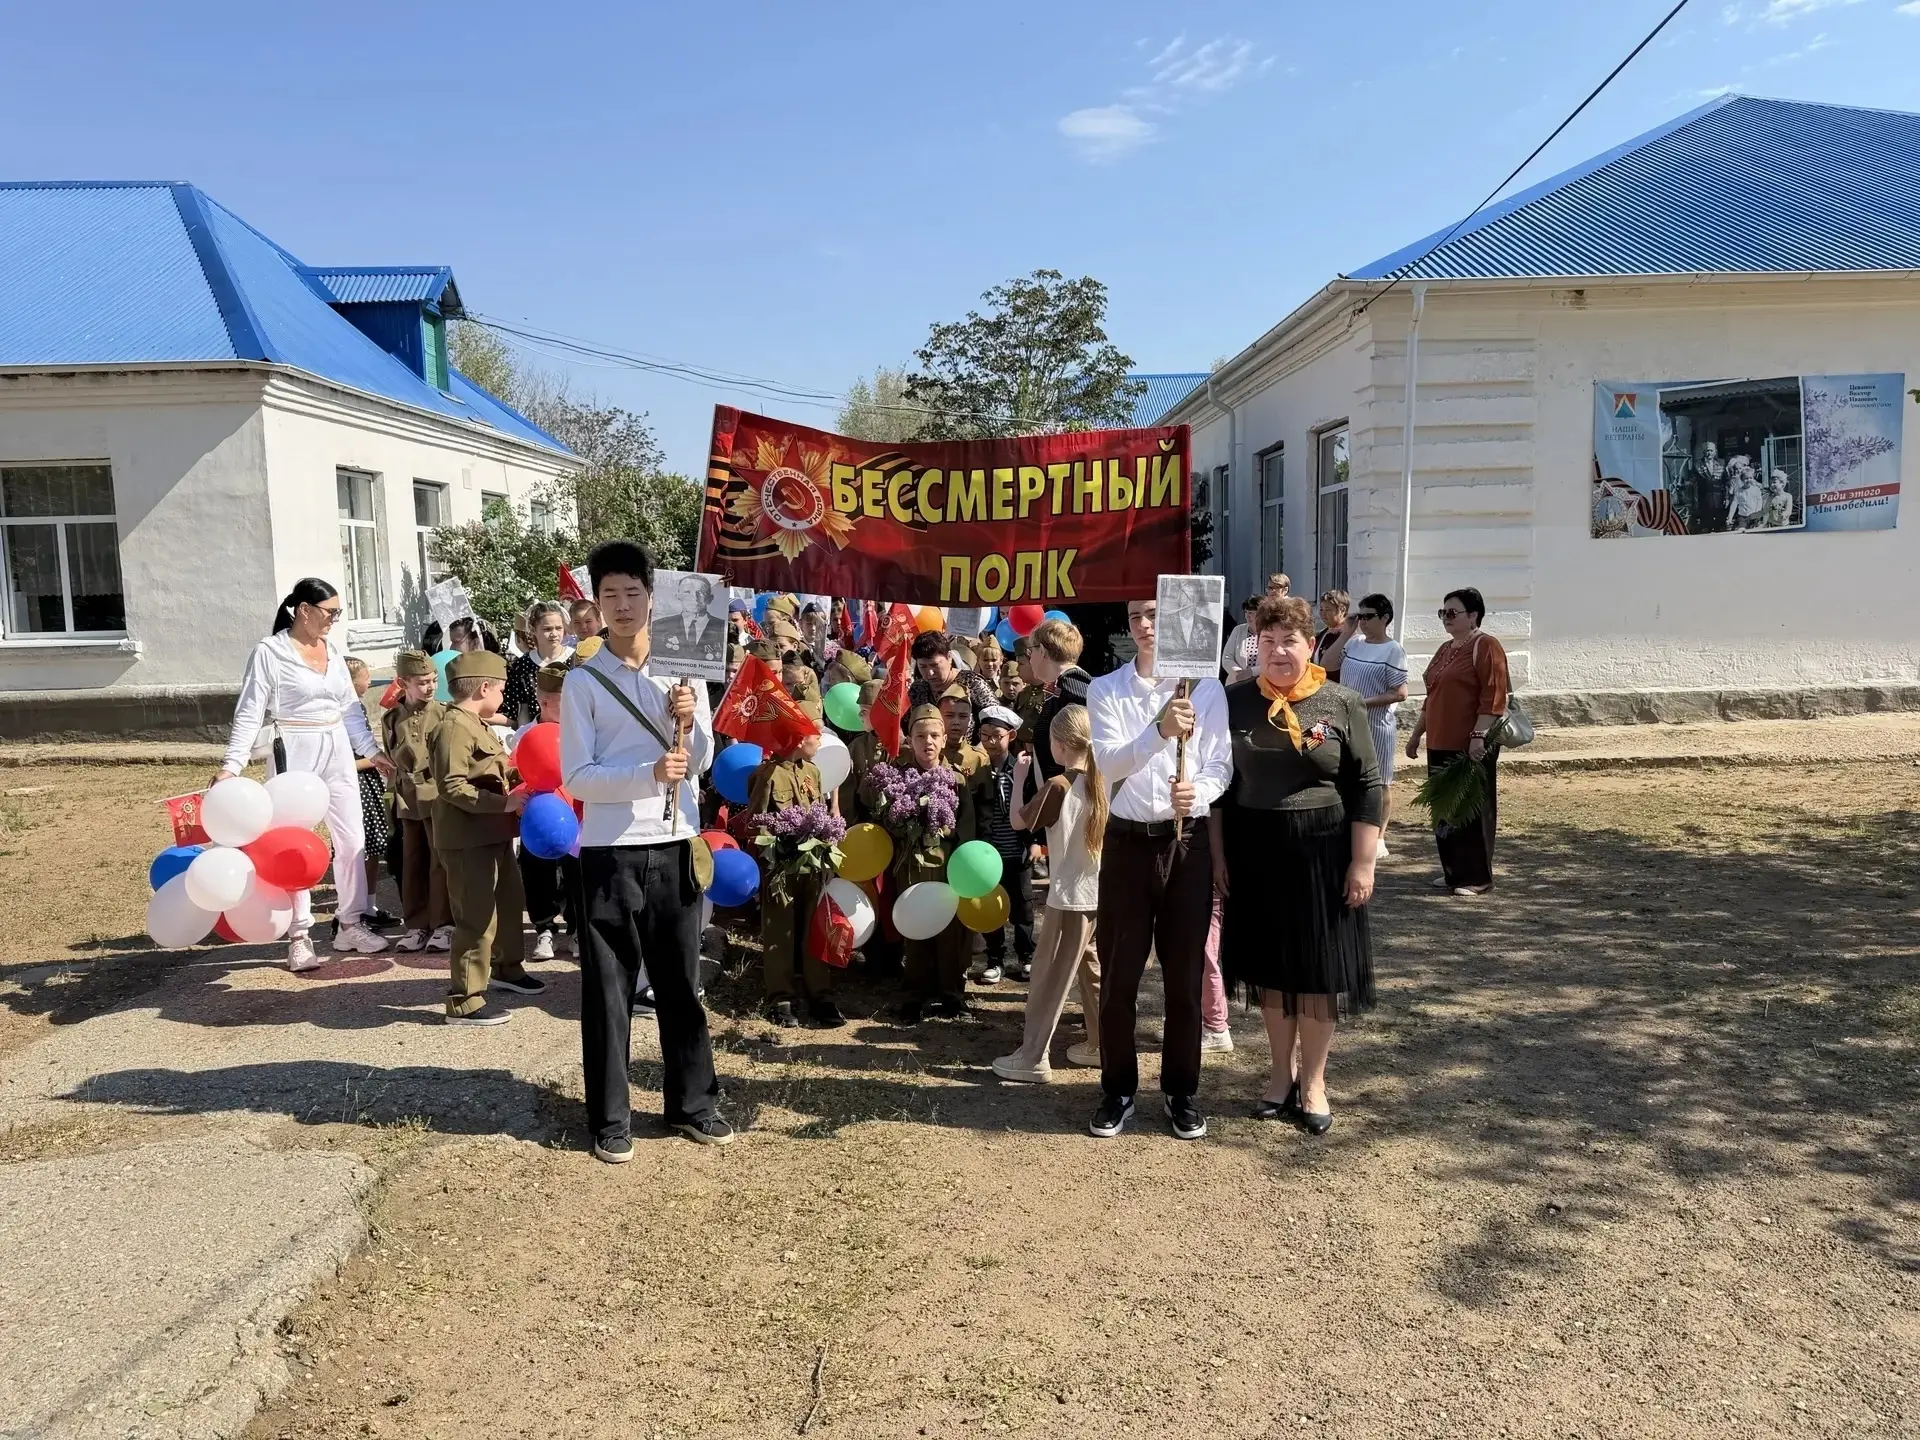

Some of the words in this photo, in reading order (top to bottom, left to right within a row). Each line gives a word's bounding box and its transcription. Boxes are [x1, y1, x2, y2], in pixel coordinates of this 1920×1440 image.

[1604, 433, 1645, 441] ВЕТЕРАНЫ
[1611, 425, 1637, 433] НАШИ
[831, 439, 1181, 524] БЕССМЕРТНЫЙ
[764, 469, 817, 522] ОТЕЧЕСТВЕННАЯ
[806, 495, 823, 525] ВОЙНА
[1819, 490, 1846, 502] Ради
[1848, 488, 1881, 499] этого
[1812, 504, 1832, 514] Мы
[1835, 496, 1889, 512] победили!
[938, 548, 1078, 603] ПОЛК
[651, 658, 697, 668] Подосинников
[698, 663, 725, 671] Николай
